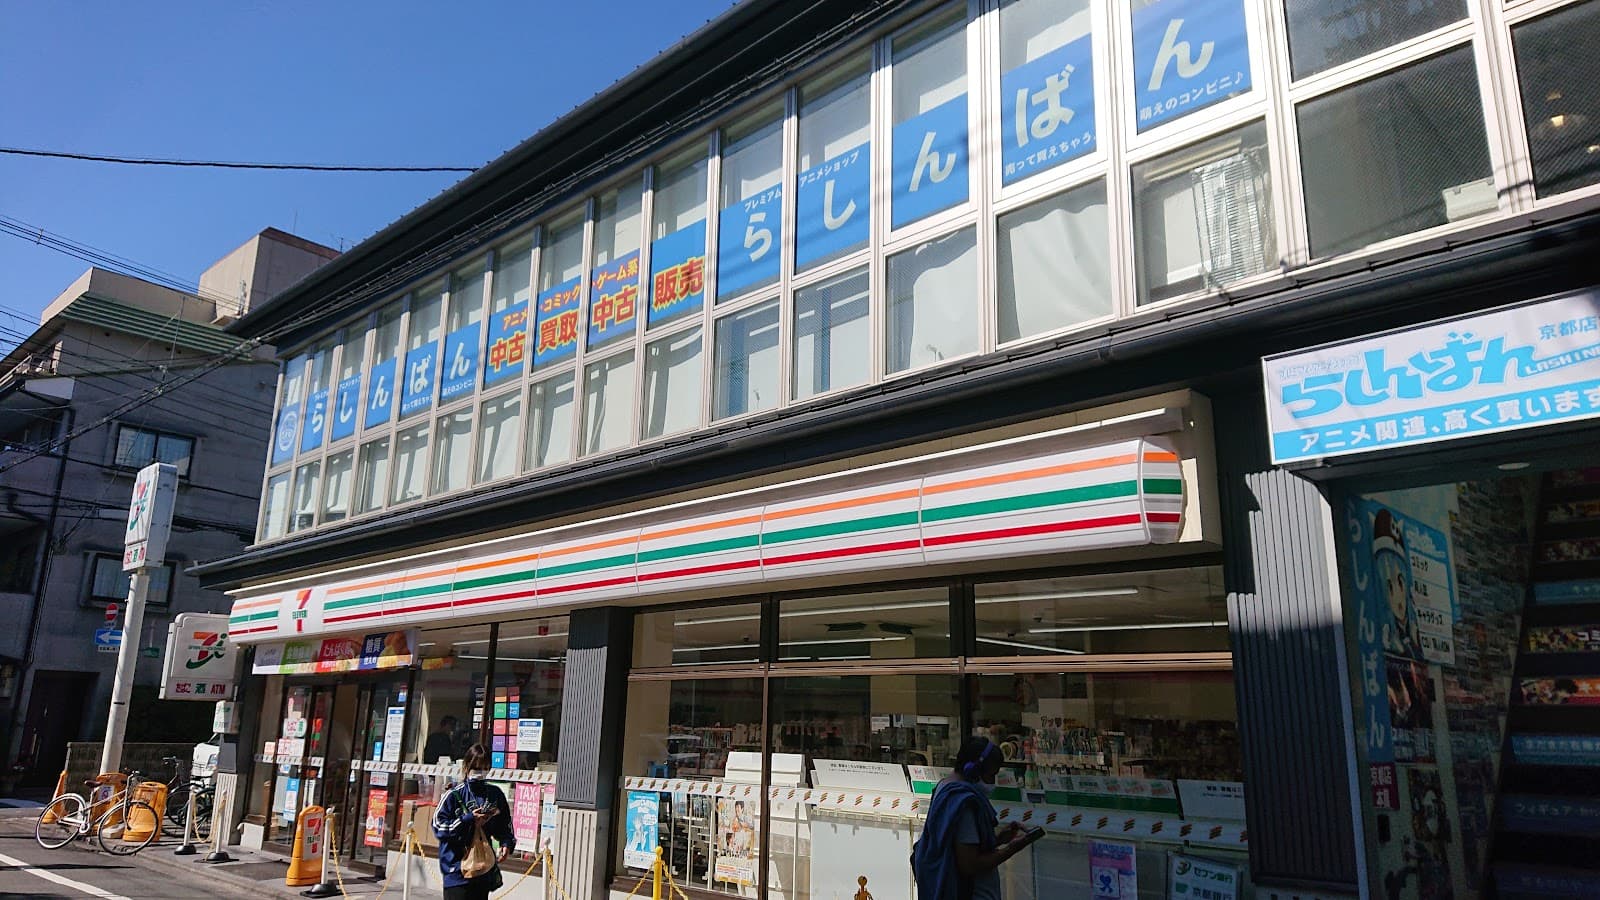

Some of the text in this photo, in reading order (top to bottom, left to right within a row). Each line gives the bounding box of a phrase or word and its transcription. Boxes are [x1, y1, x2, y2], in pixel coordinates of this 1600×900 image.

[744, 151, 859, 212] プレミアム アニメショップ
[1539, 316, 1597, 340] 京都店
[1281, 331, 1537, 419] らしんばん
[211, 683, 226, 695] ATM
[517, 801, 536, 817] FREE
